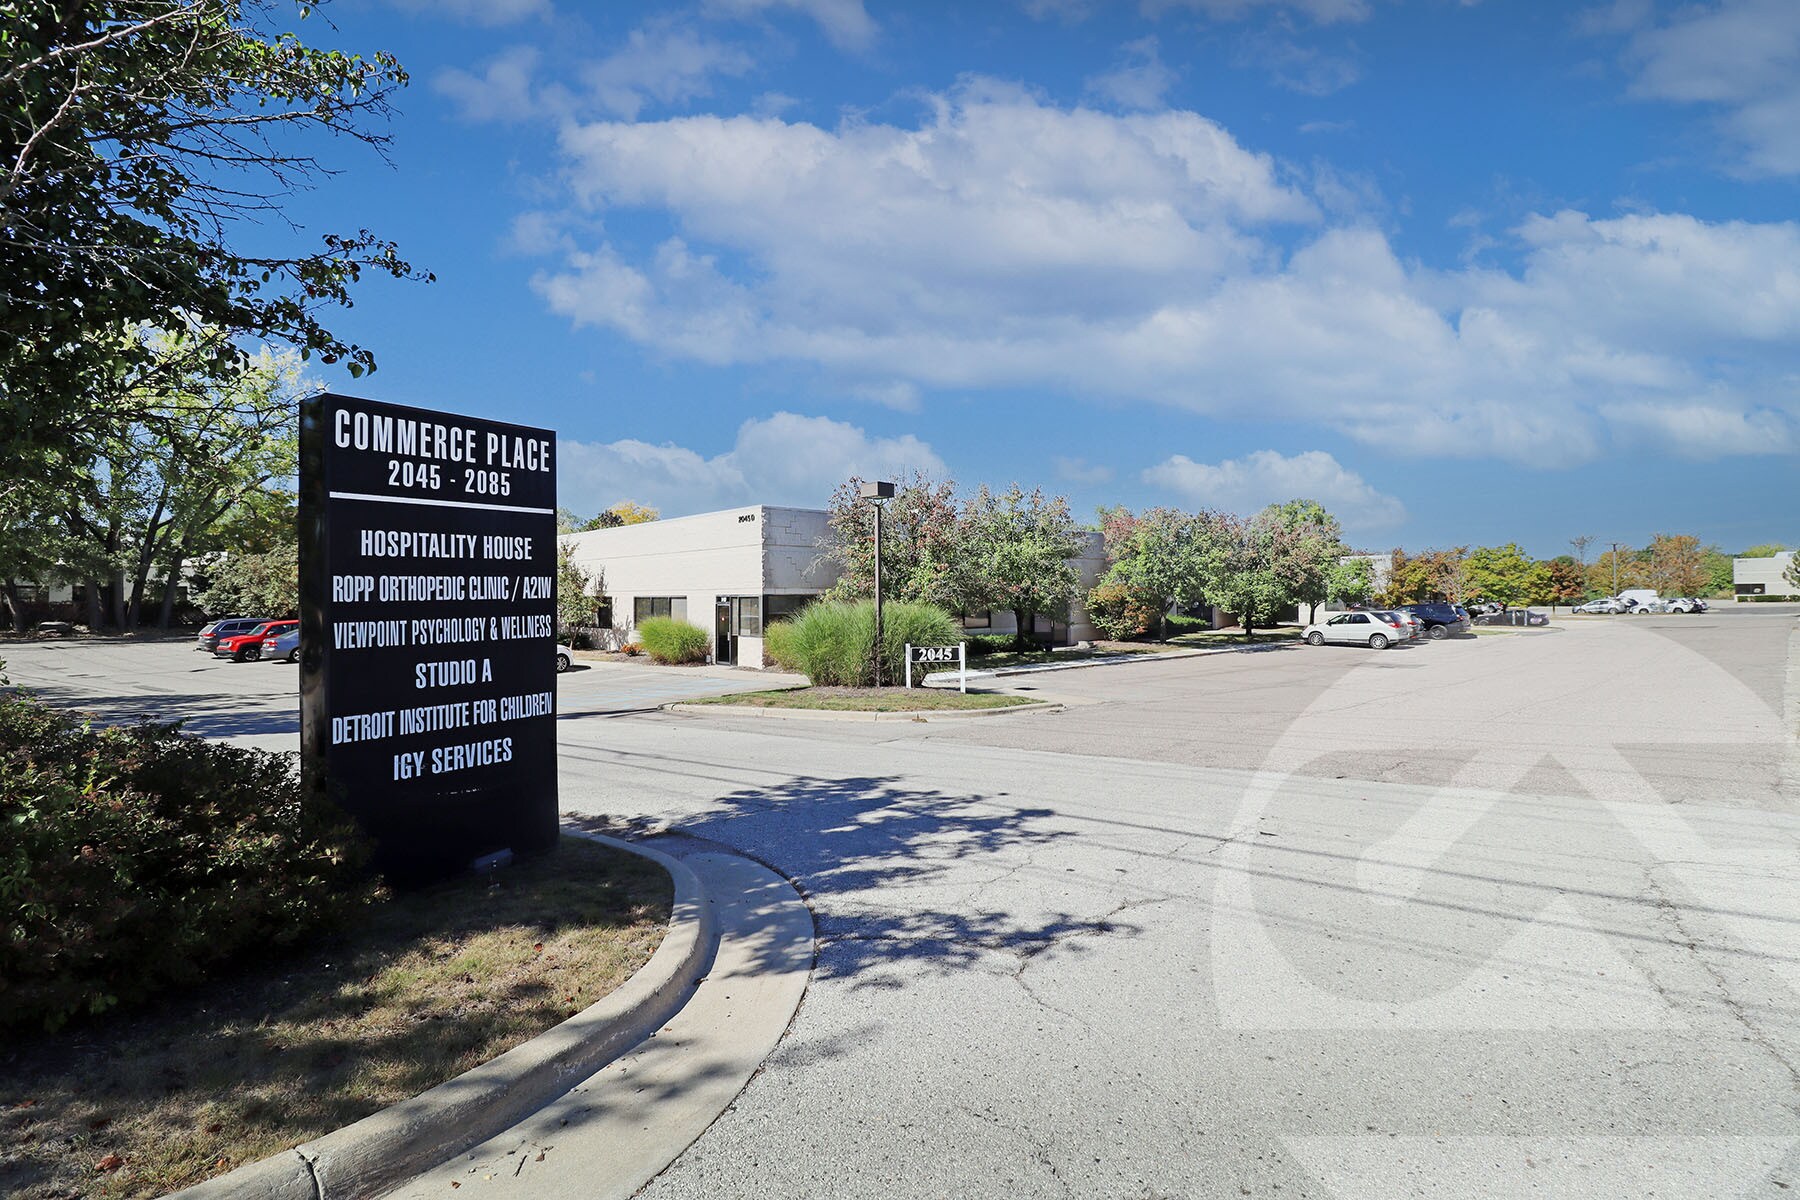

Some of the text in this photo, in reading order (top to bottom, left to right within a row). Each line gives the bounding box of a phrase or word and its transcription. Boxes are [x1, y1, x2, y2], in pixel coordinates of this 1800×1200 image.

[335, 408, 550, 473] COMMERCE PLACE
[388, 459, 441, 490] 2045
[465, 468, 511, 497] 2085
[360, 529, 533, 561] HOSPITALITY HOUSE
[332, 575, 375, 603] ROPP
[379, 575, 465, 602] ORTHOPEDIC
[469, 575, 510, 601] CLINIC
[511, 575, 520, 603] /
[333, 614, 552, 650] VIEWPOINT PSYCHOLOGY & WELLNESS
[918, 647, 953, 661] 2045
[415, 658, 493, 689] STUDIO A
[332, 691, 553, 745] DETROIT INSTITUTE FOR CHILDREN
[393, 737, 513, 781] IGY SERVICES
